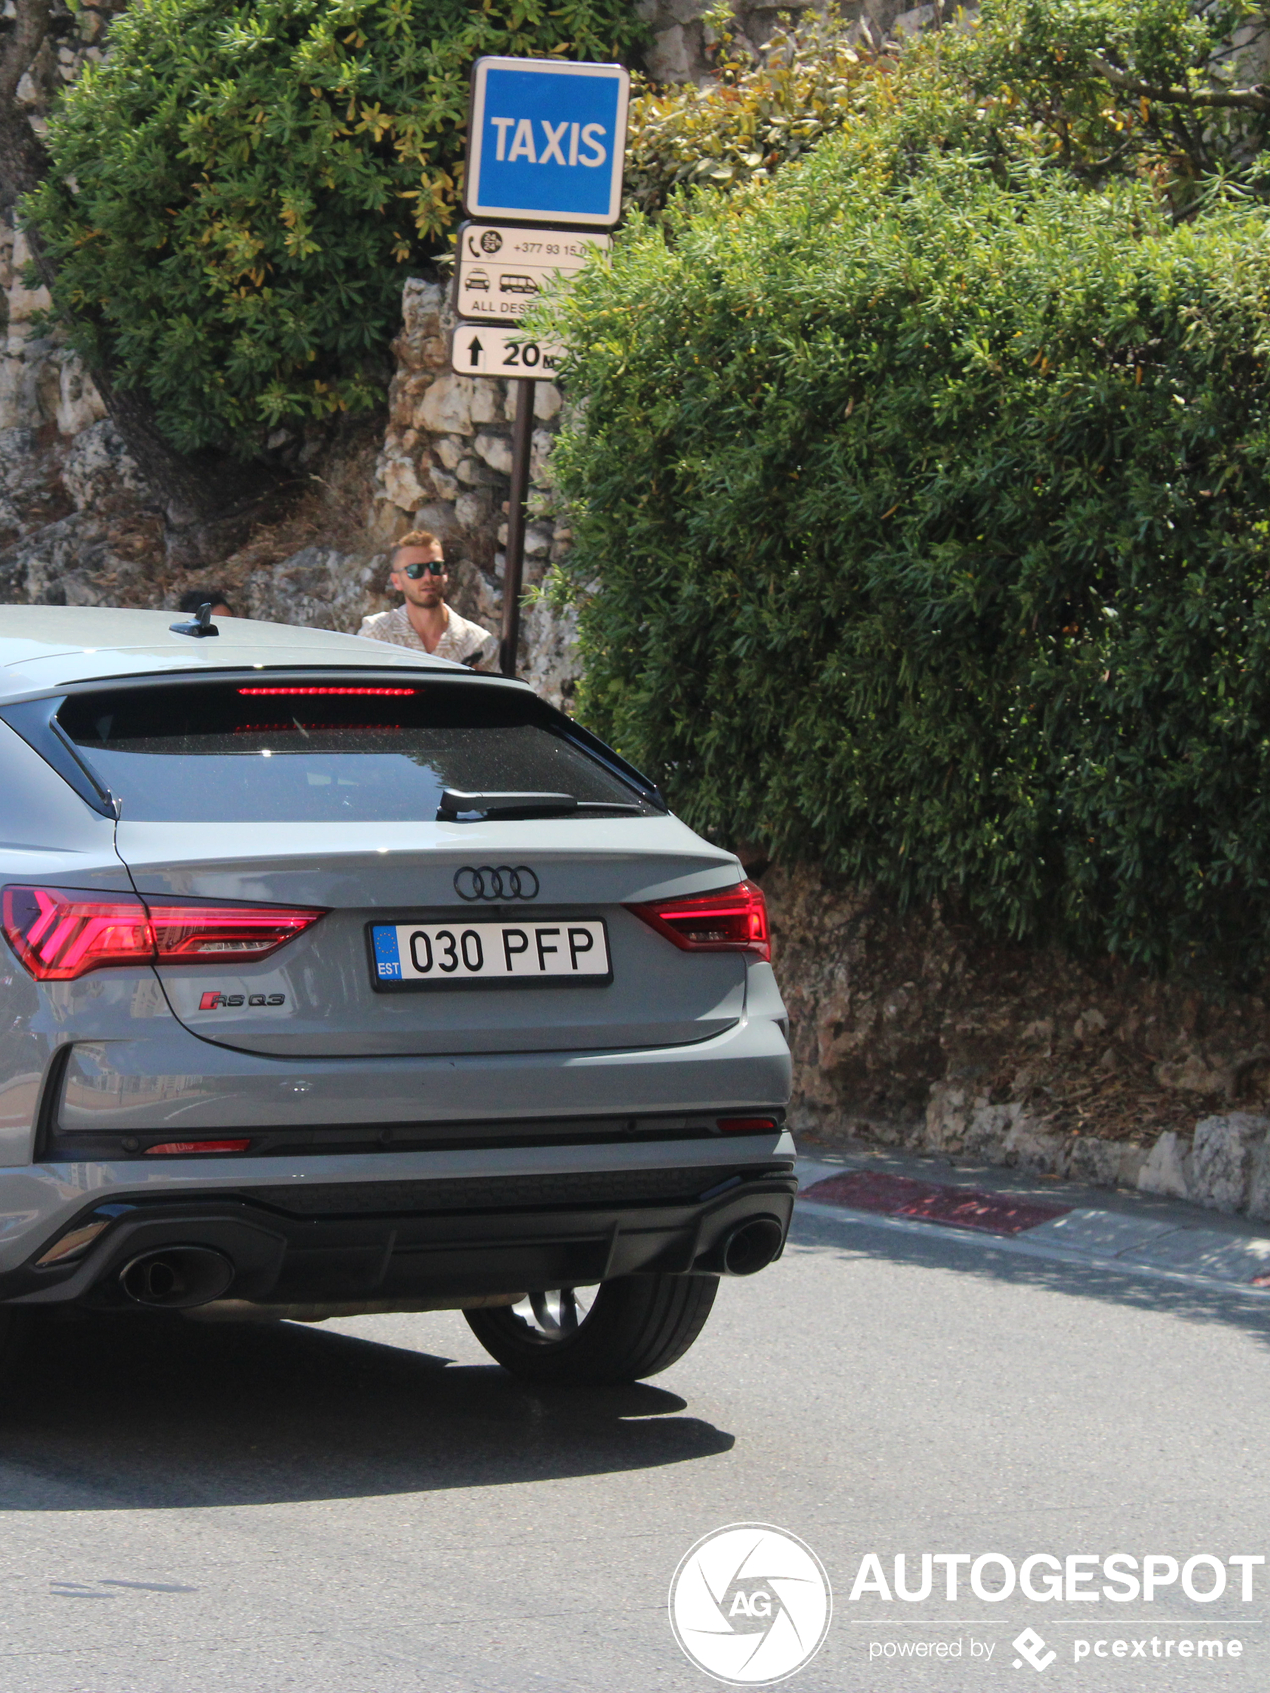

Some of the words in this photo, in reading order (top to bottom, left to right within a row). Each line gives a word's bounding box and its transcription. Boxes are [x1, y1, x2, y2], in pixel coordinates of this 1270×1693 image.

[491, 117, 607, 167] TAXIS
[514, 242, 543, 253] +377
[546, 244, 560, 254] 93
[564, 245, 577, 255] 15
[472, 301, 496, 312] ALL
[410, 929, 484, 973] 030
[502, 928, 594, 971] PFP
[378, 962, 400, 975] EST
[211, 994, 245, 1007] RS
[248, 993, 286, 1006] Q3
